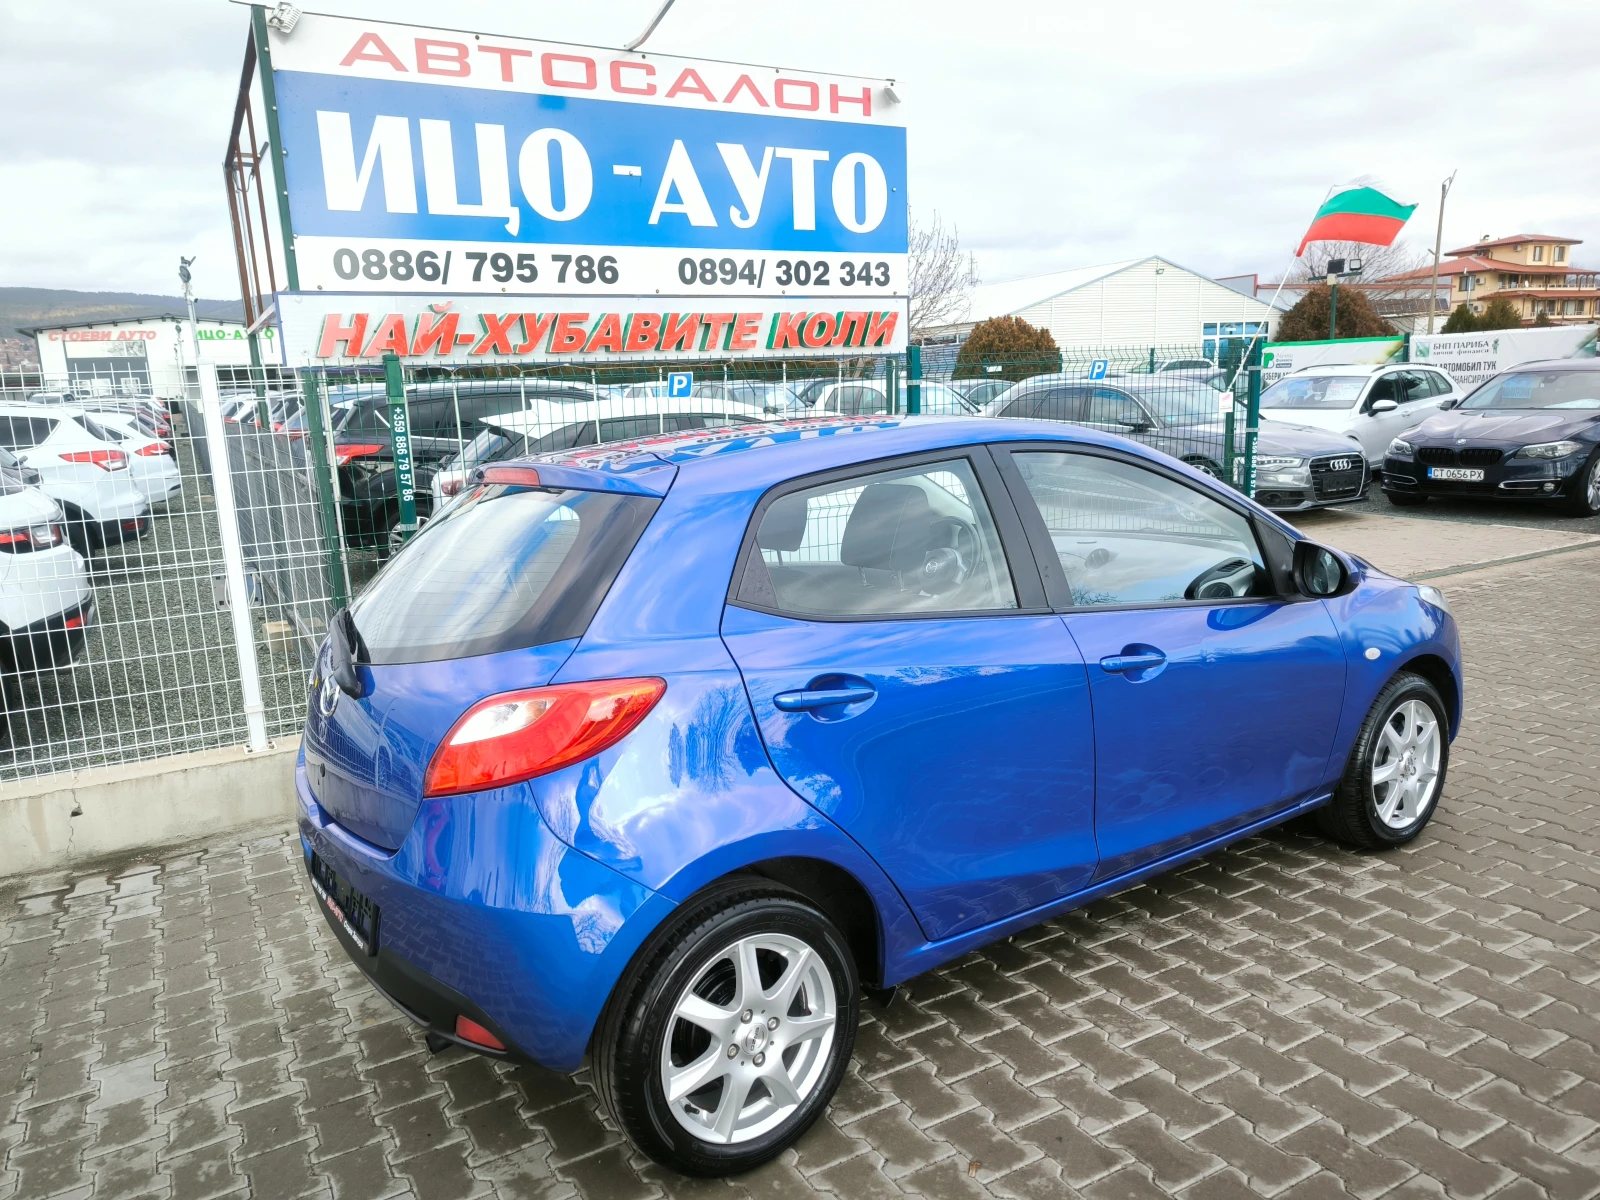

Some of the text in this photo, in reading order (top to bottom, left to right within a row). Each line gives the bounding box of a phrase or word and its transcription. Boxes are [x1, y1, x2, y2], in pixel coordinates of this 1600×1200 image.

[339, 31, 872, 117] АВТОСАЛОН
[316, 110, 593, 237] ИЦО
[333, 248, 619, 285] 0886/ 795 786
[678, 257, 891, 288] 0894/ 302 343
[48, 330, 157, 342] СТОЕВИ АУТО
[317, 300, 899, 358] НАЙ-ХУБАВИТЕ КОЛИ
[1433, 340, 1489, 350] БНП ПАРИБА
[1092, 361, 1105, 379] P
[1483, 360, 1497, 371] ТУК
[672, 375, 688, 396] P
[393, 406, 414, 502] +359 886 79 57 86
[1446, 469, 1468, 479] 0656
